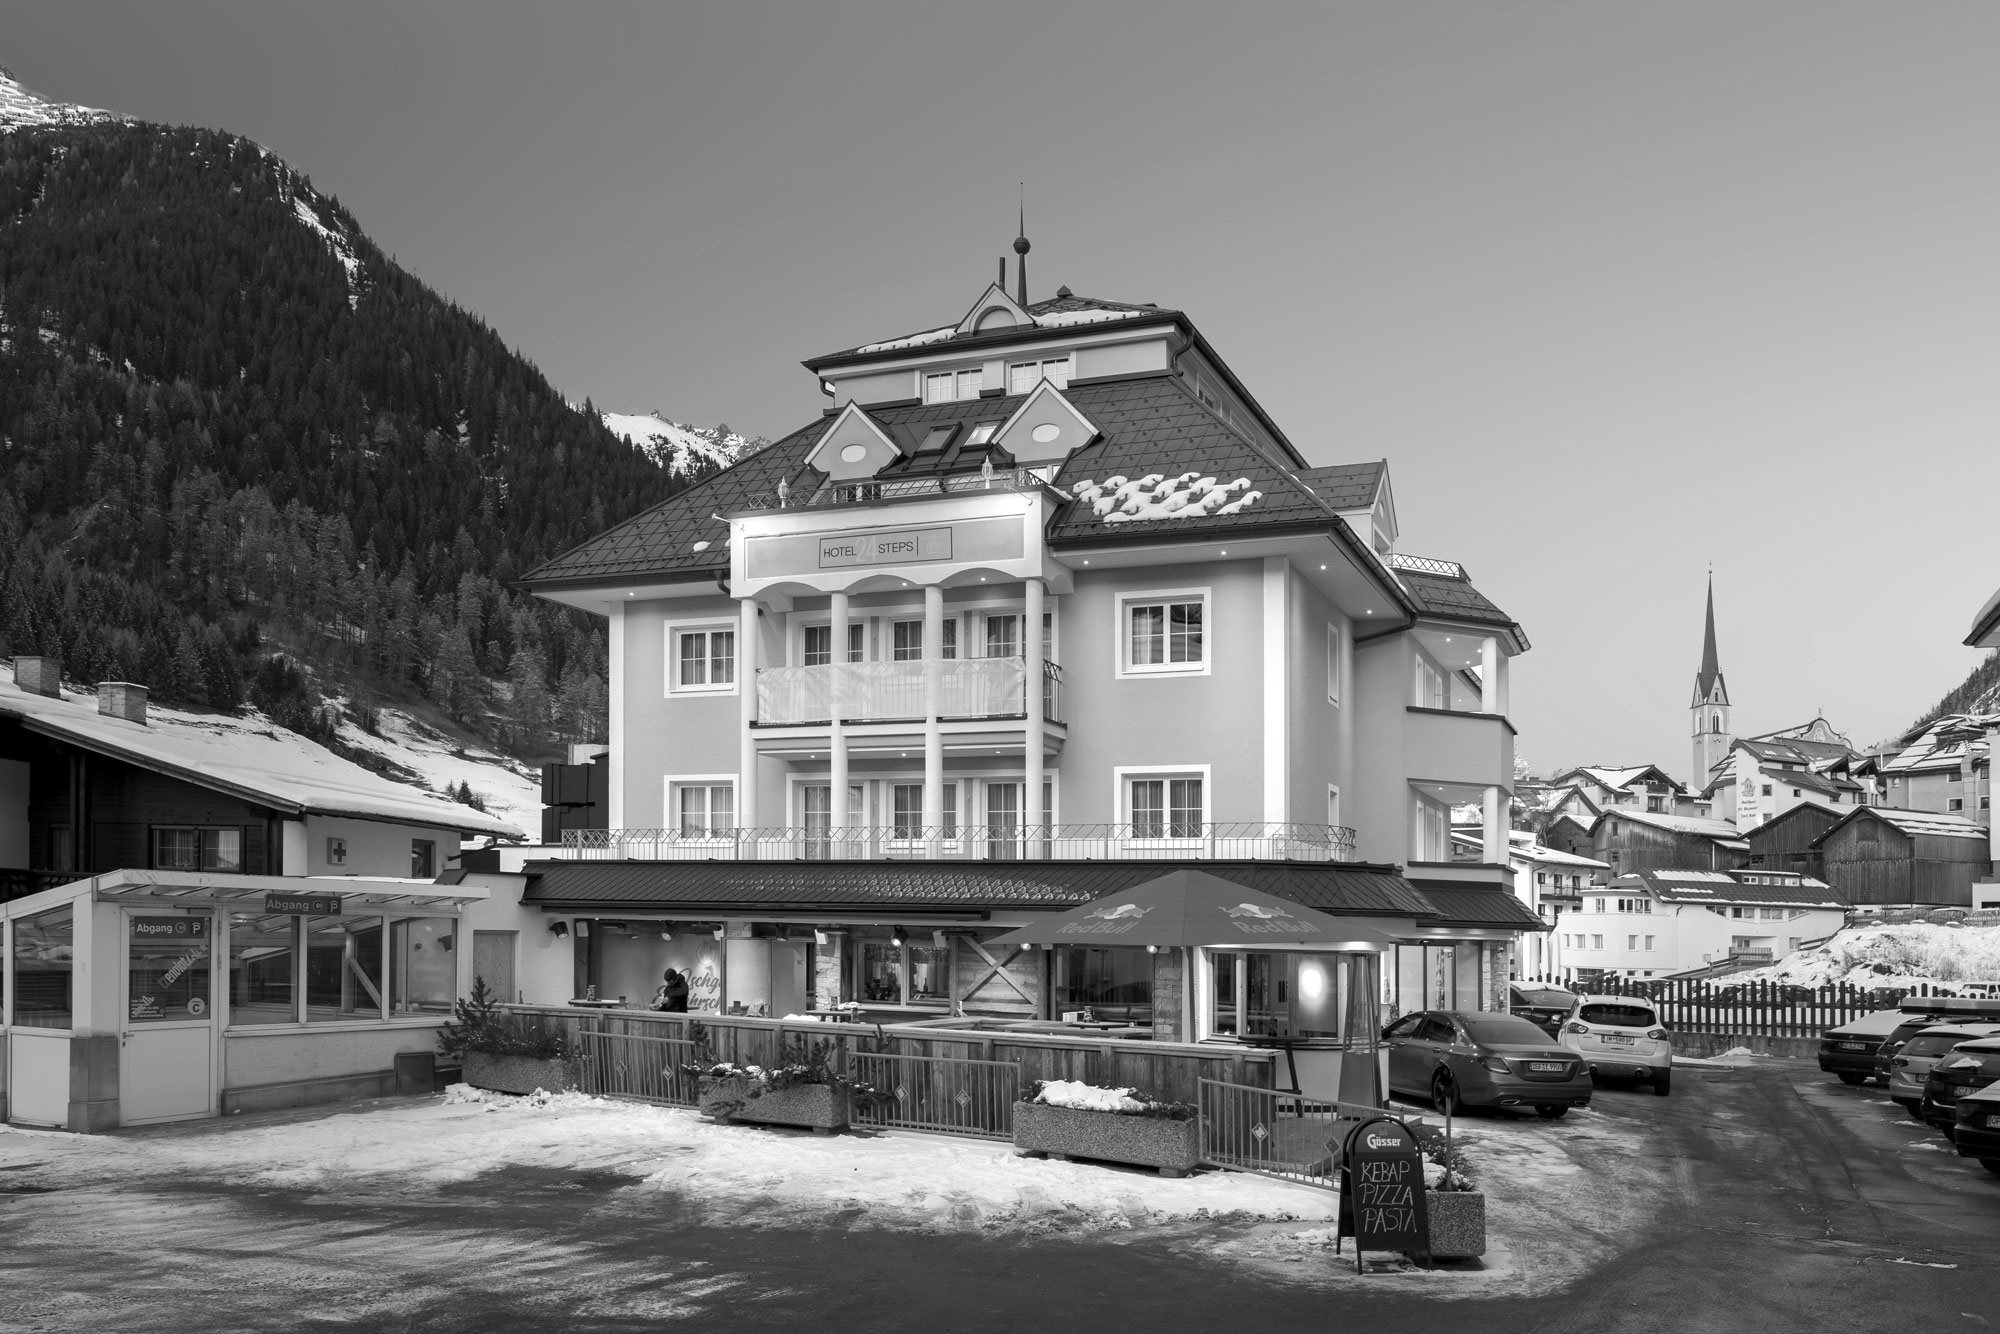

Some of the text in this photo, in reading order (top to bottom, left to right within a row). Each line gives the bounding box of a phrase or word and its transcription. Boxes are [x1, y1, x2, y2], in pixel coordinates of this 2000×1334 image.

[823, 545, 857, 558] HOTEL
[855, 536, 877, 562] 24
[878, 541, 914, 554] STEPS
[266, 899, 309, 912] Abgang
[136, 923, 173, 935] Abgang
[1366, 1133, 1401, 1149] Gösser
[1361, 1160, 1411, 1183] KEBAP
[1359, 1183, 1414, 1206] PIZZA
[1361, 1207, 1418, 1234] PASTA
